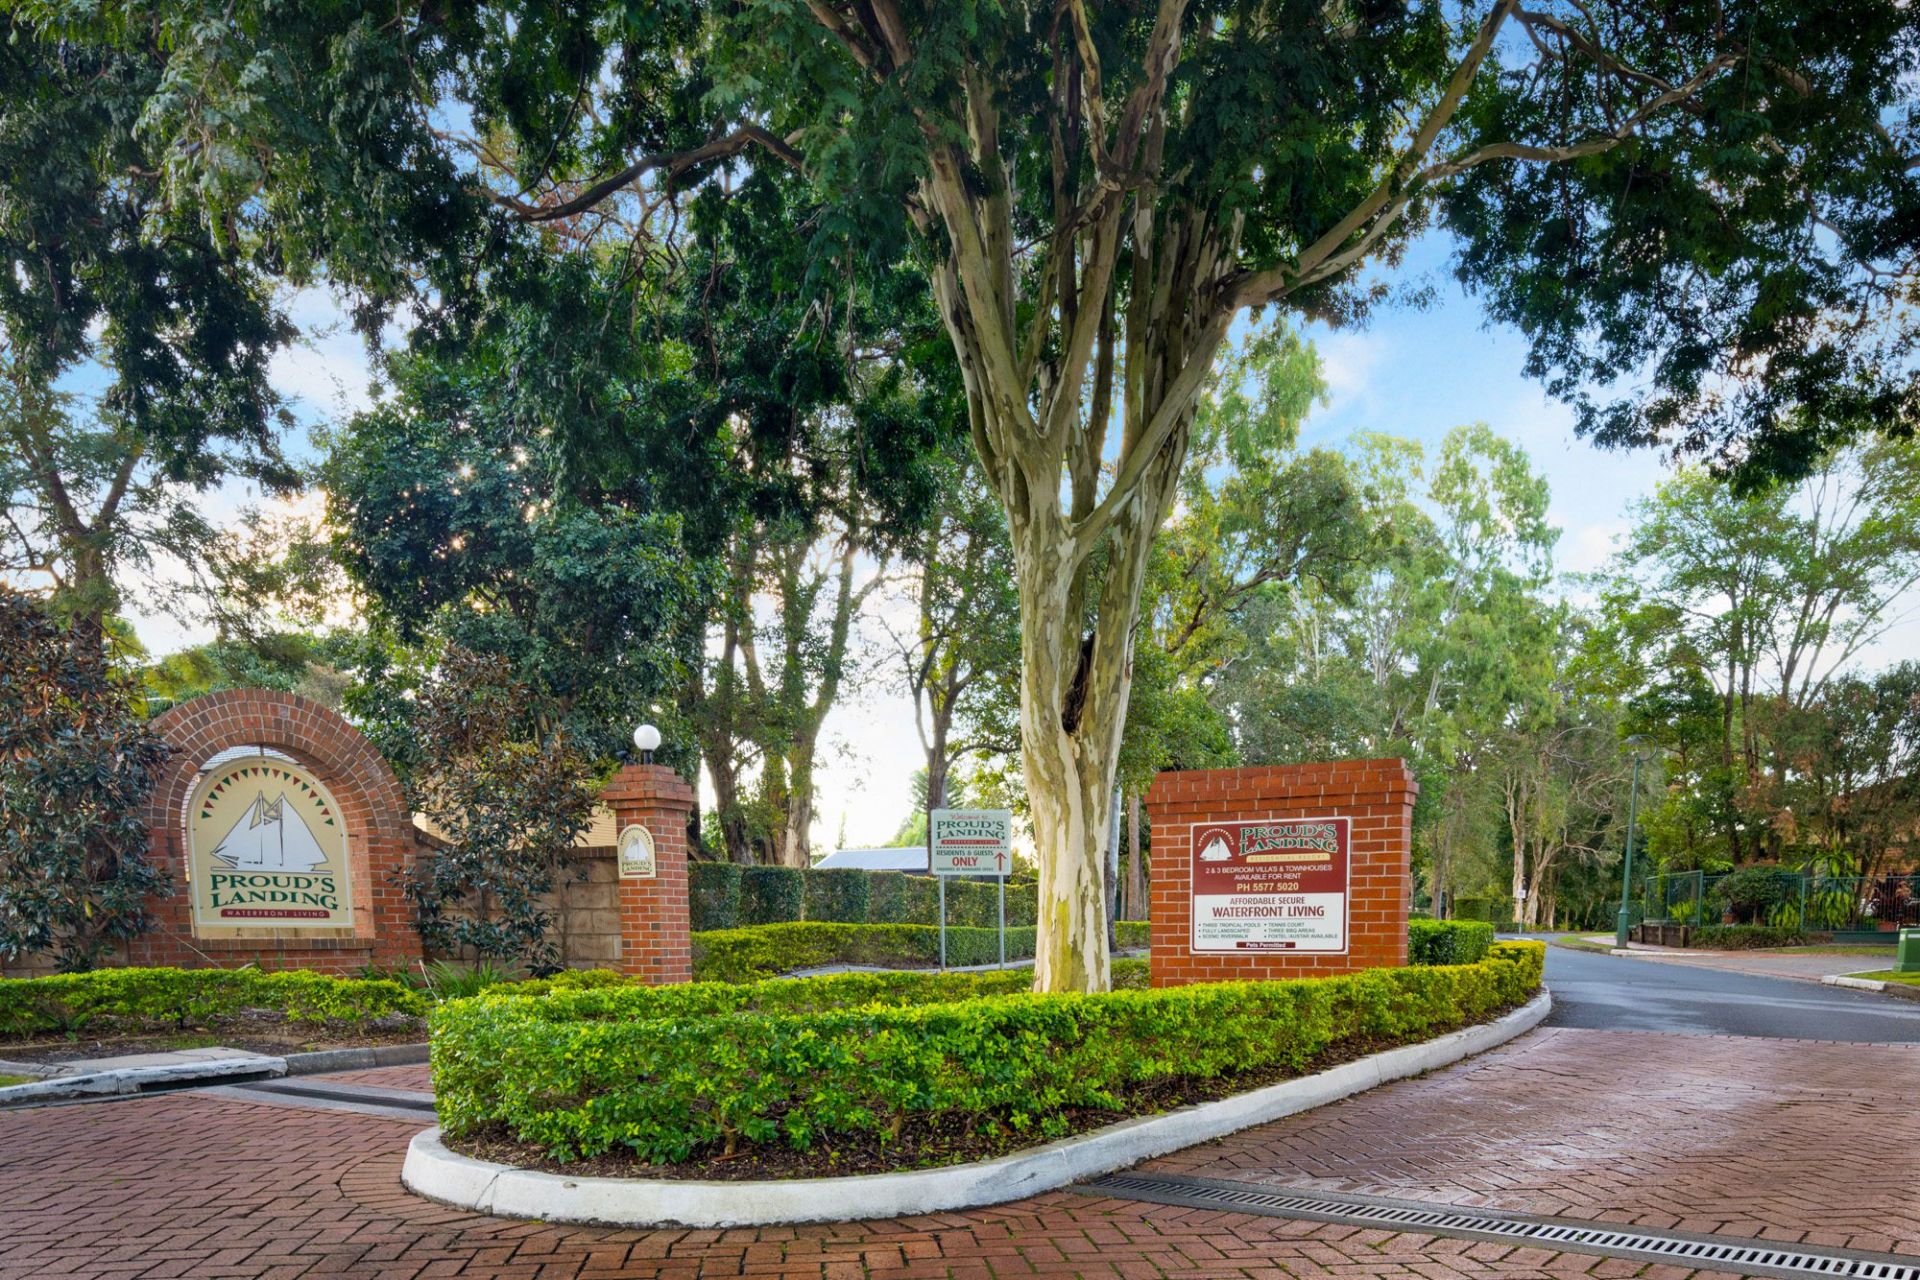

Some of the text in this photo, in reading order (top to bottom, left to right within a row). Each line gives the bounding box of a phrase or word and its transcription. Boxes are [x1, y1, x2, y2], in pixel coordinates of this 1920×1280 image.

[936, 820, 1005, 831] PROUD'S
[936, 829, 1006, 840] LANDING
[1239, 823, 1338, 840] PROUD'S
[1238, 837, 1339, 857] LANDING
[952, 856, 978, 867] ONLY
[1222, 866, 1254, 874] BEDROOM
[1285, 864, 1333, 872] TOWNHOUSES
[1284, 872, 1302, 880] RENT
[210, 874, 336, 894] PROUD'S
[1236, 882, 1299, 892] PH 5577 5020
[210, 890, 339, 911] LANDING
[1230, 896, 1306, 905] AFFORDABLE SECURE
[1212, 905, 1325, 918] WATERFRONT LIVING
